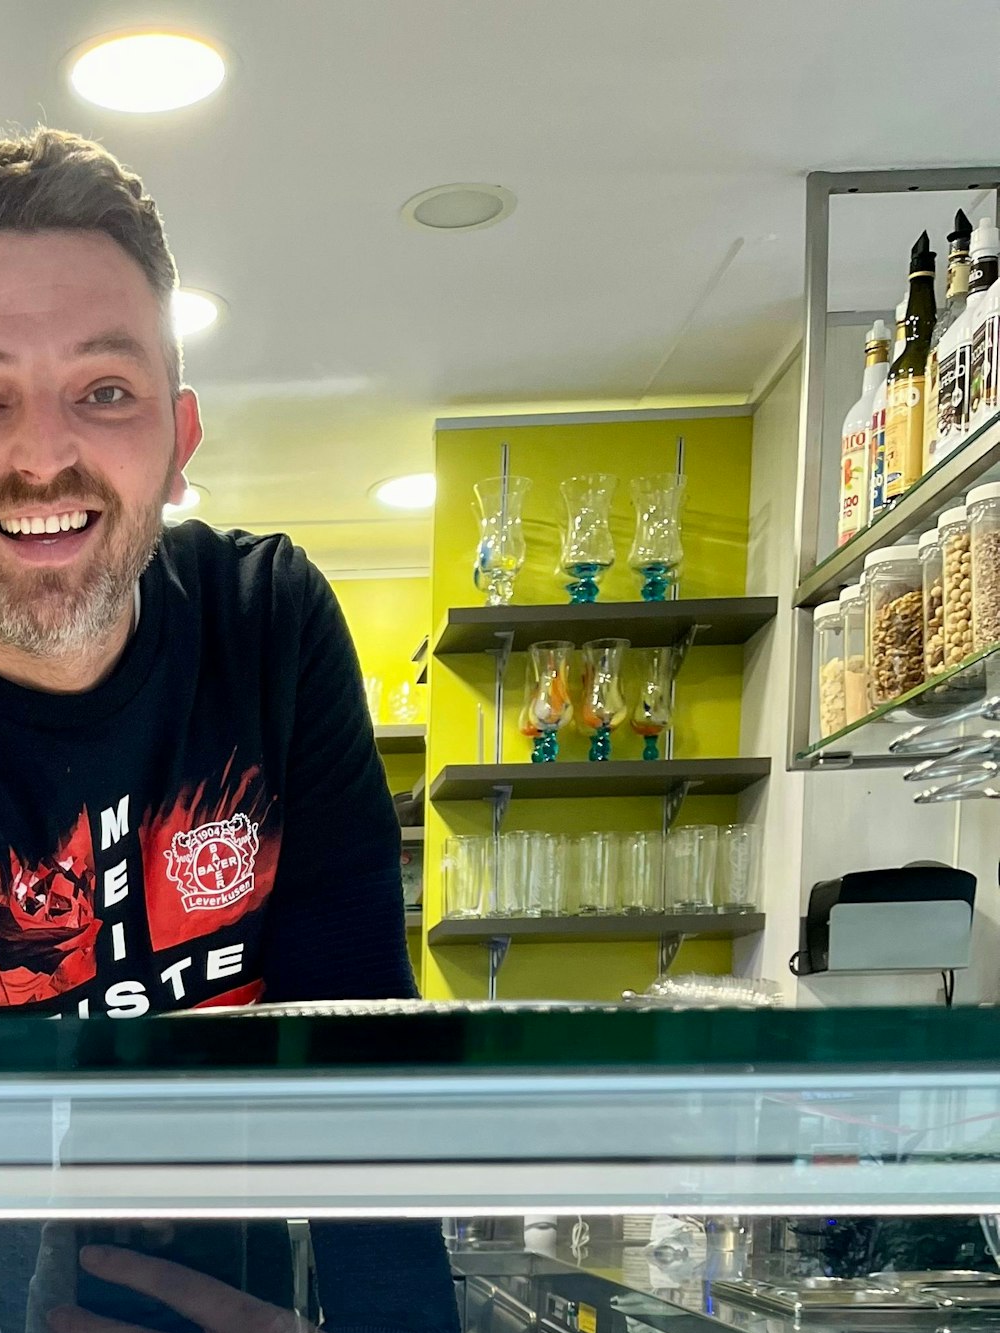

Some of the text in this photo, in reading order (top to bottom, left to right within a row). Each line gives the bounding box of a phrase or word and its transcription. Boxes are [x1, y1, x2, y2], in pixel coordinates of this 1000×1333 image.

[197, 827, 221, 841] 1904
[197, 856, 238, 877] BAYER
[209, 843, 225, 890] BAYER
[188, 880, 251, 908] Leverkusen
